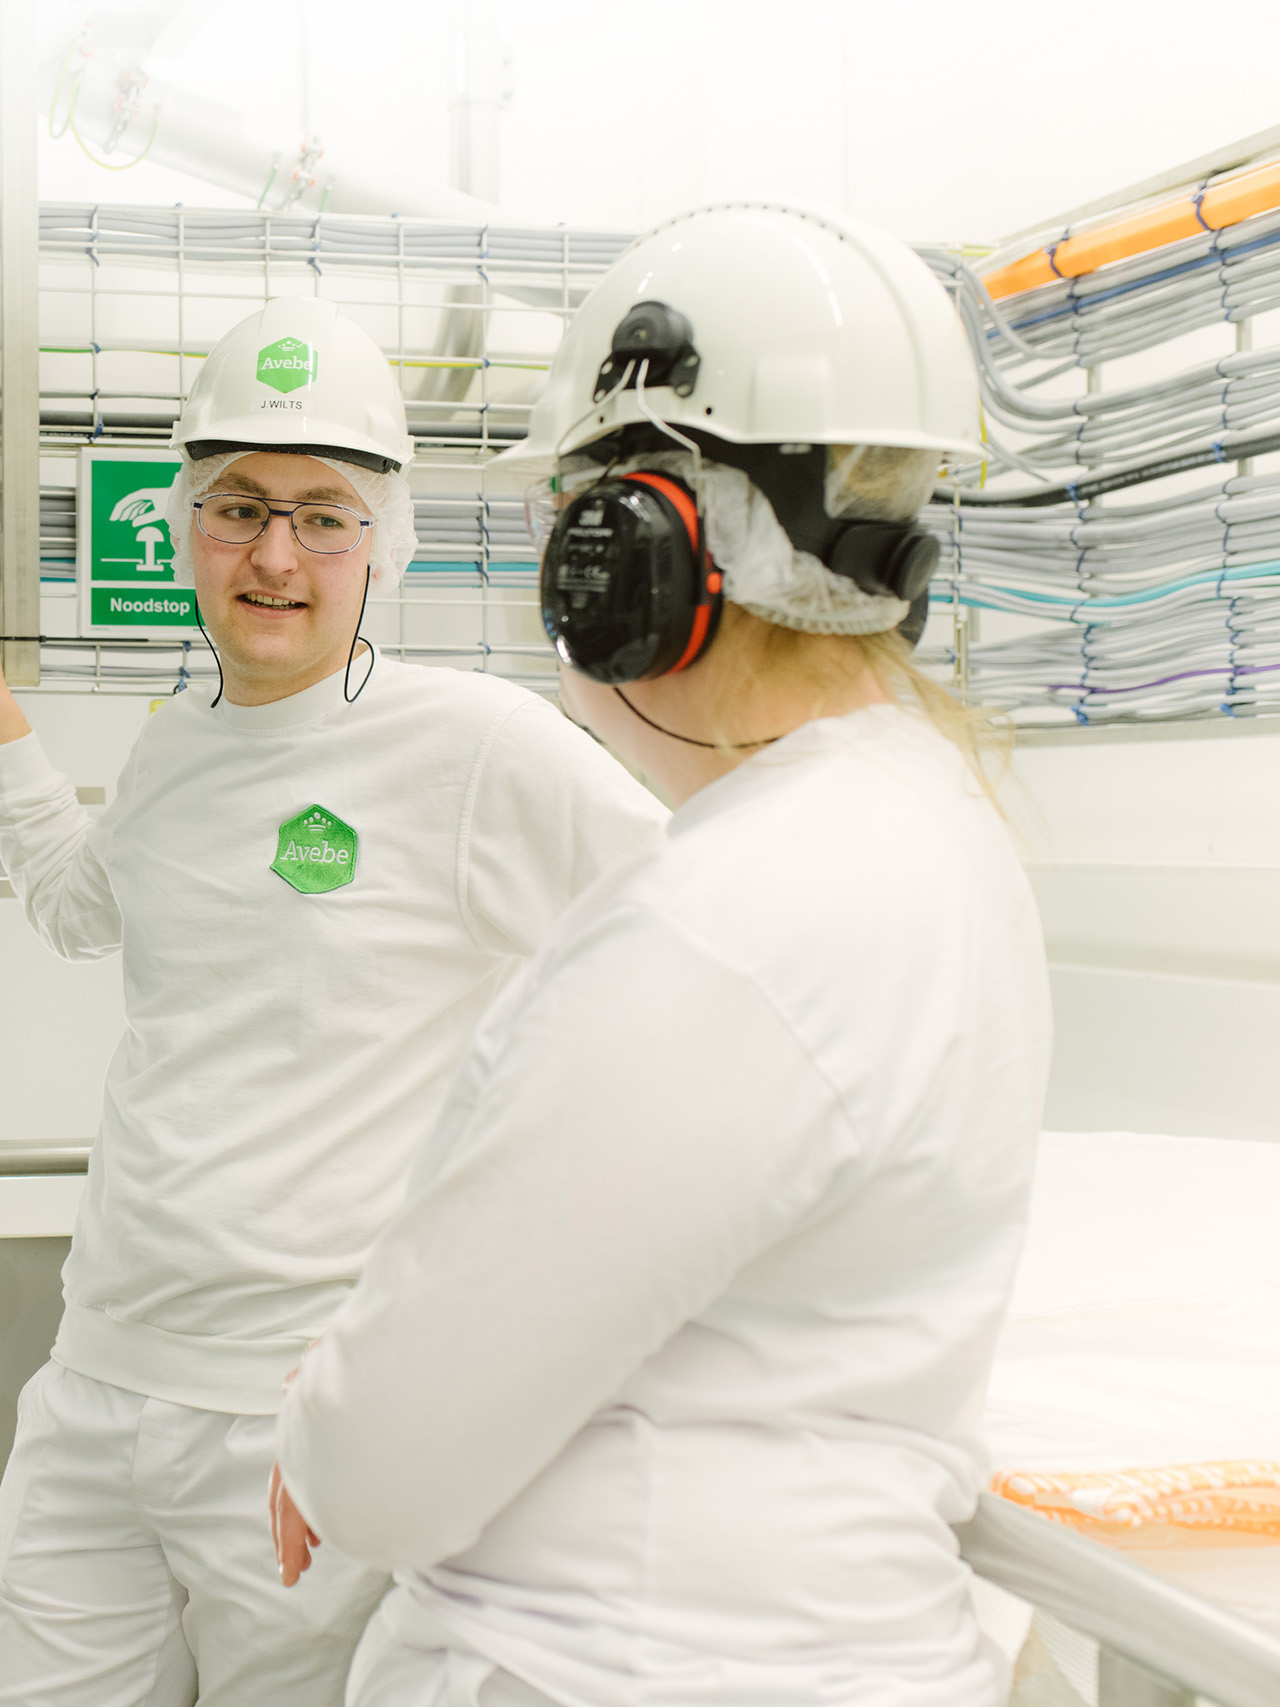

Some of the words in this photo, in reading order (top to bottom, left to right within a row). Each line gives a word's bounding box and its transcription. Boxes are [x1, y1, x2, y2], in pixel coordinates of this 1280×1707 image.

[261, 356, 311, 370] Avebe
[261, 401, 302, 409] J.WILTS
[110, 598, 190, 616] Noodstop
[280, 840, 348, 864] Avebe
